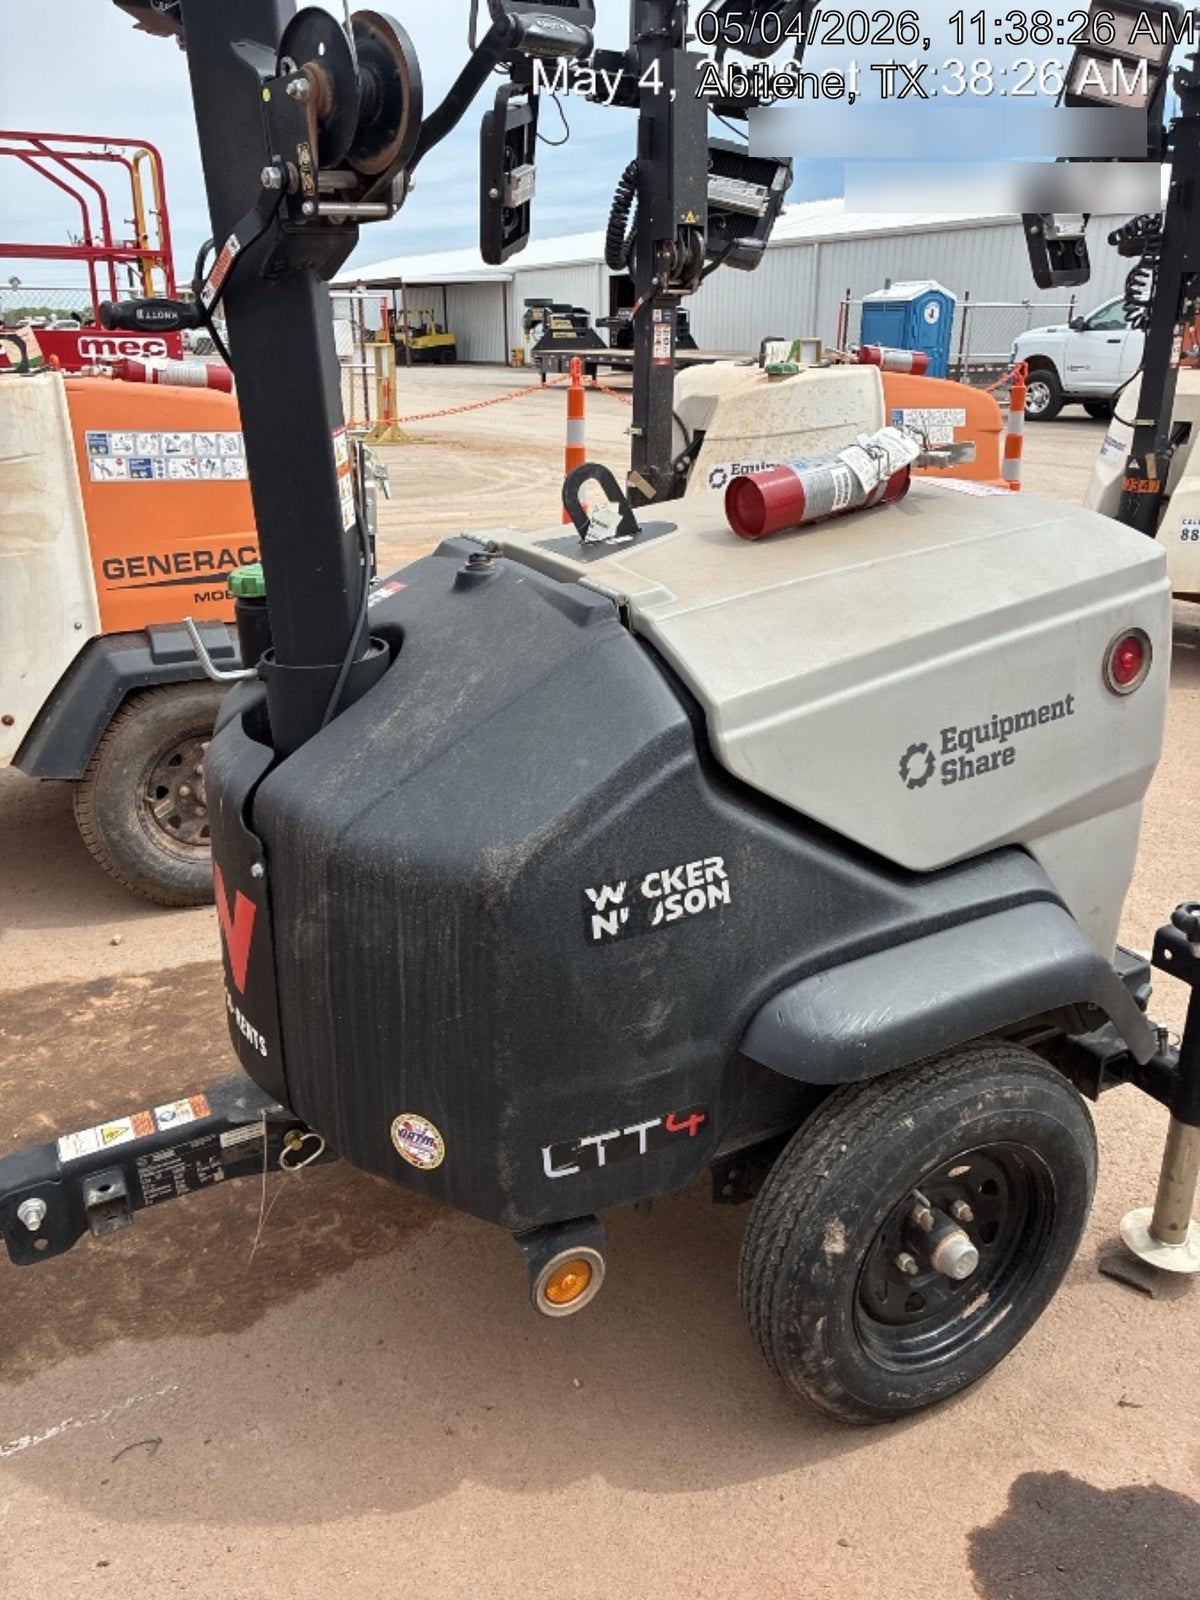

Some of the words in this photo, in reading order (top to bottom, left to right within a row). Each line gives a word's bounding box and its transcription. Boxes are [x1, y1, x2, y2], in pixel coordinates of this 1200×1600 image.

[80, 338, 166, 357] mec
[102, 546, 259, 580] GENERAC
[940, 693, 1075, 755] Equipment
[940, 746, 1017, 786] Share
[585, 856, 728, 911] WCKER
[592, 880, 731, 940] NSON
[541, 1111, 705, 1179] LTT4
